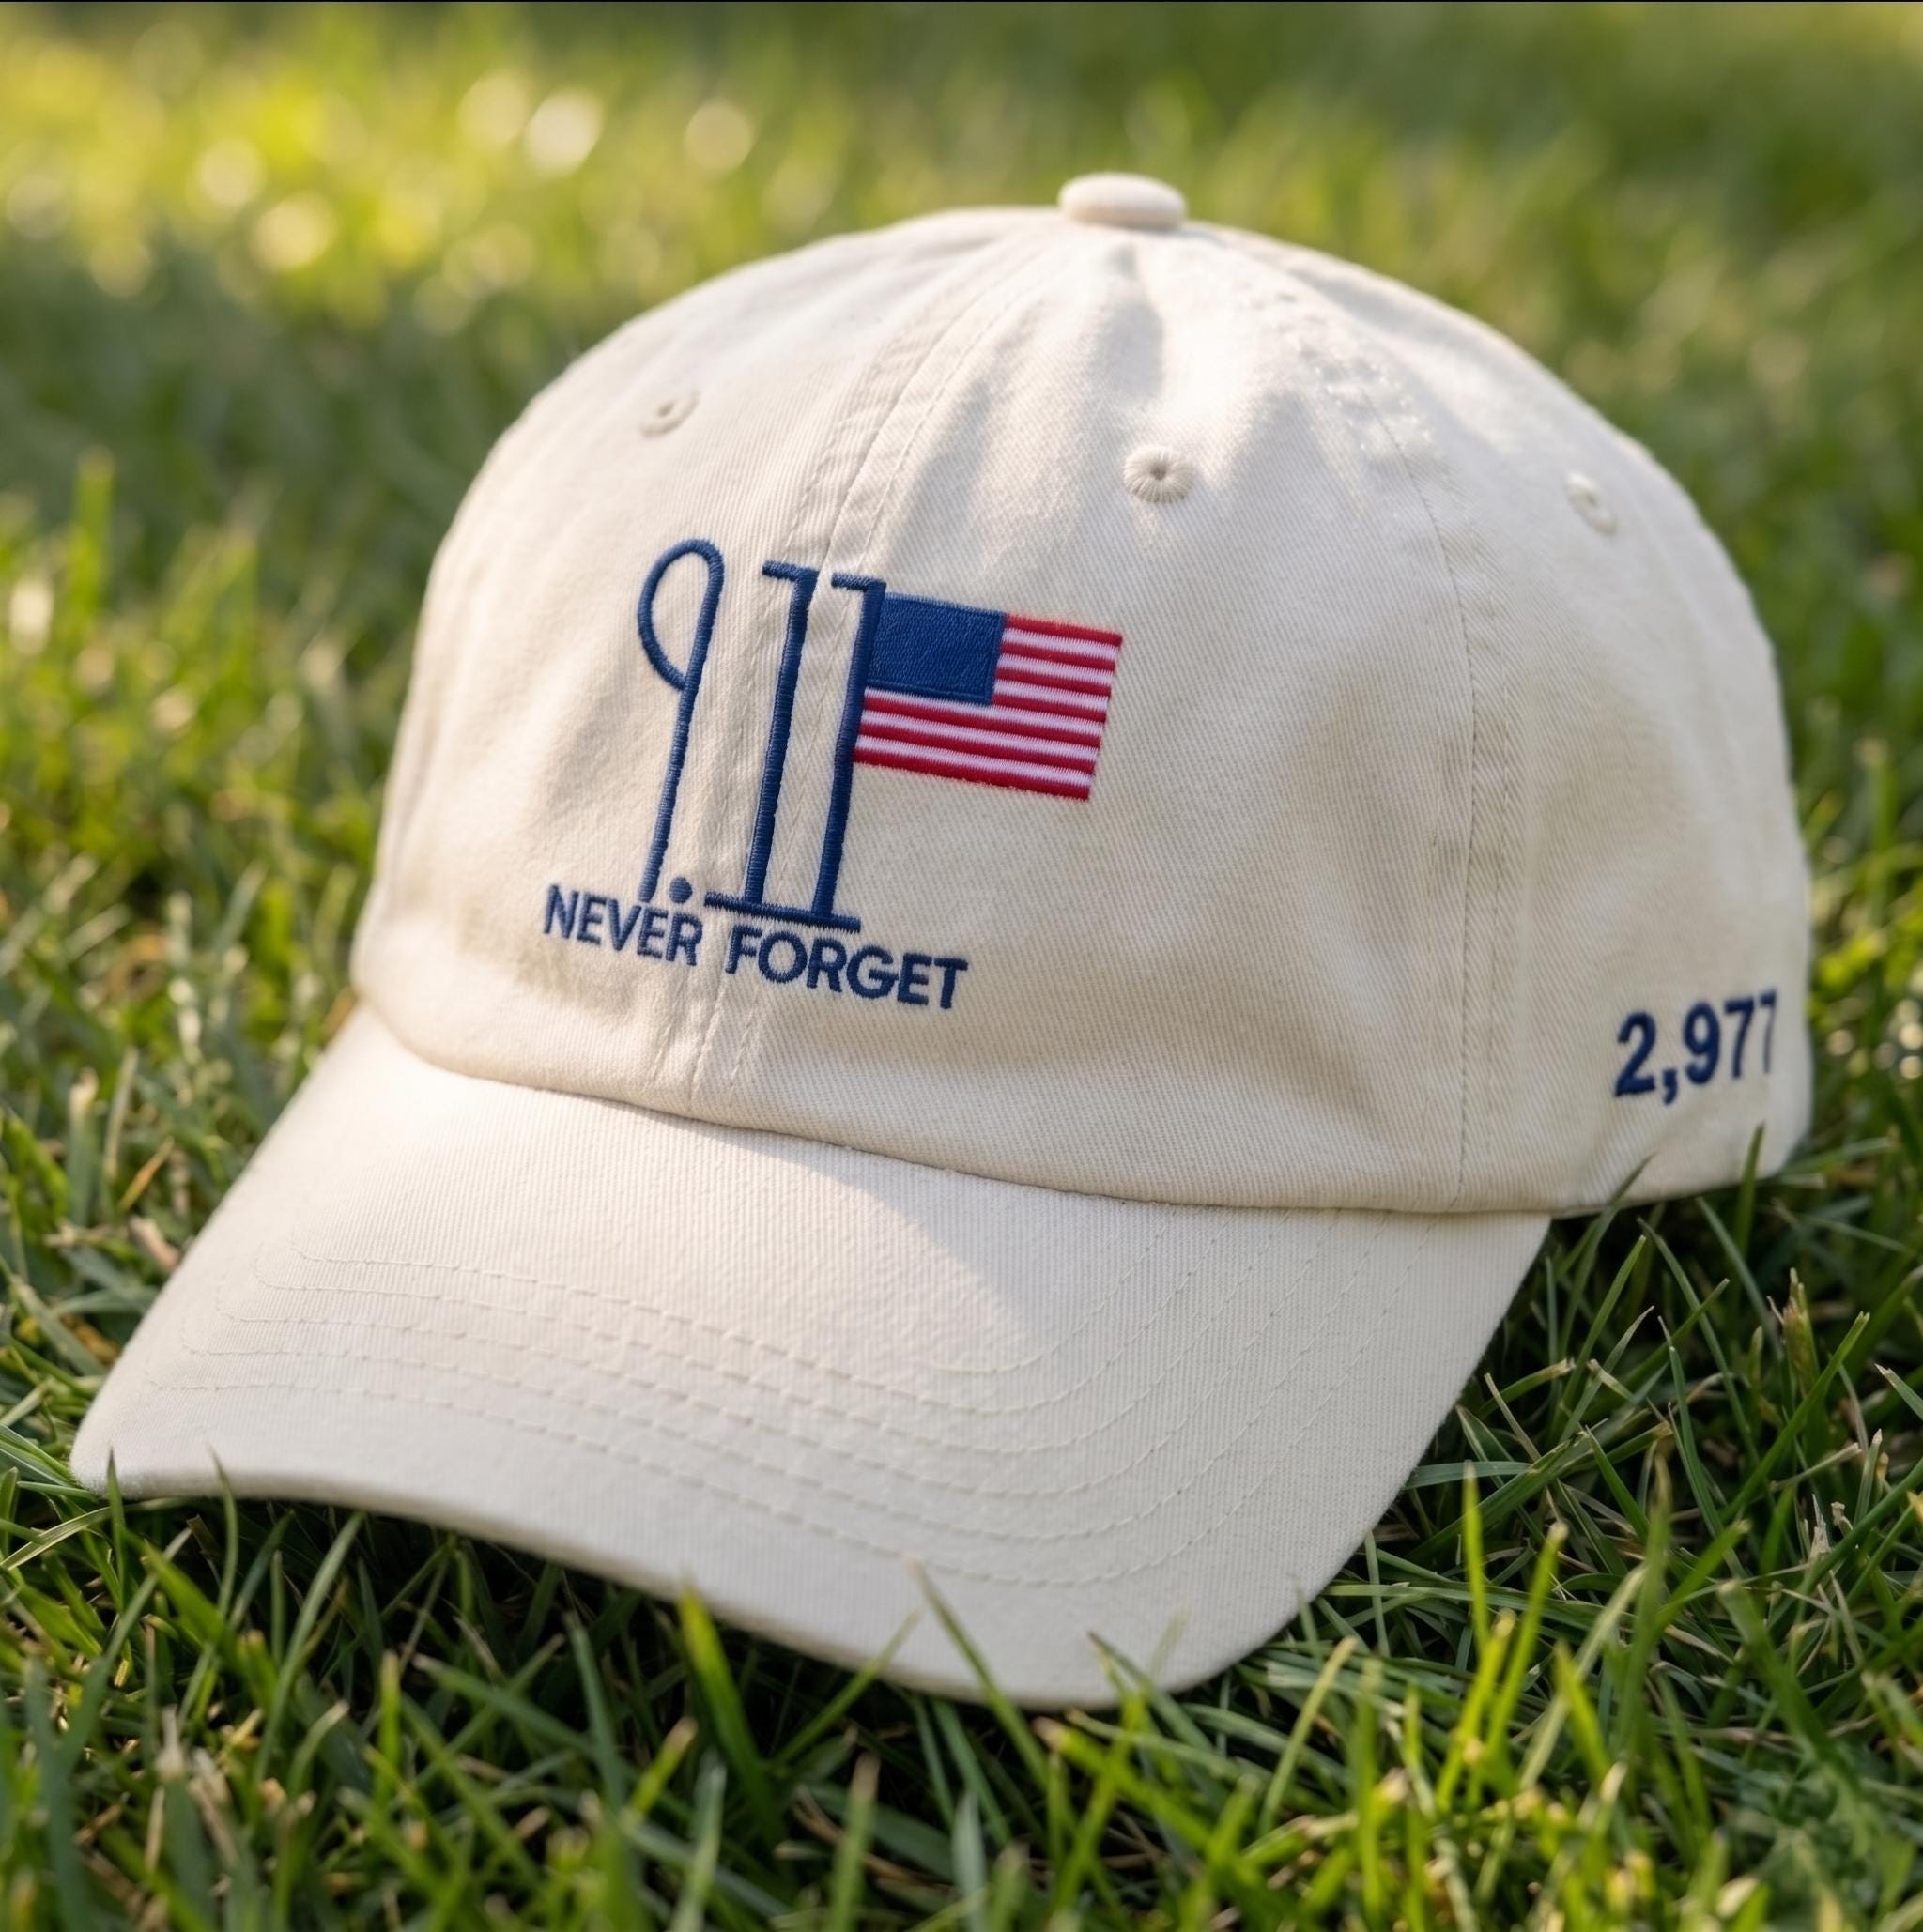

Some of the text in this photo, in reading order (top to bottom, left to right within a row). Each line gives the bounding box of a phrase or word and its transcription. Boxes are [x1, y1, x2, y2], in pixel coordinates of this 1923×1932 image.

[543, 884, 968, 1009] NEVER FORGET
[1614, 989, 1777, 1106] 2,977
